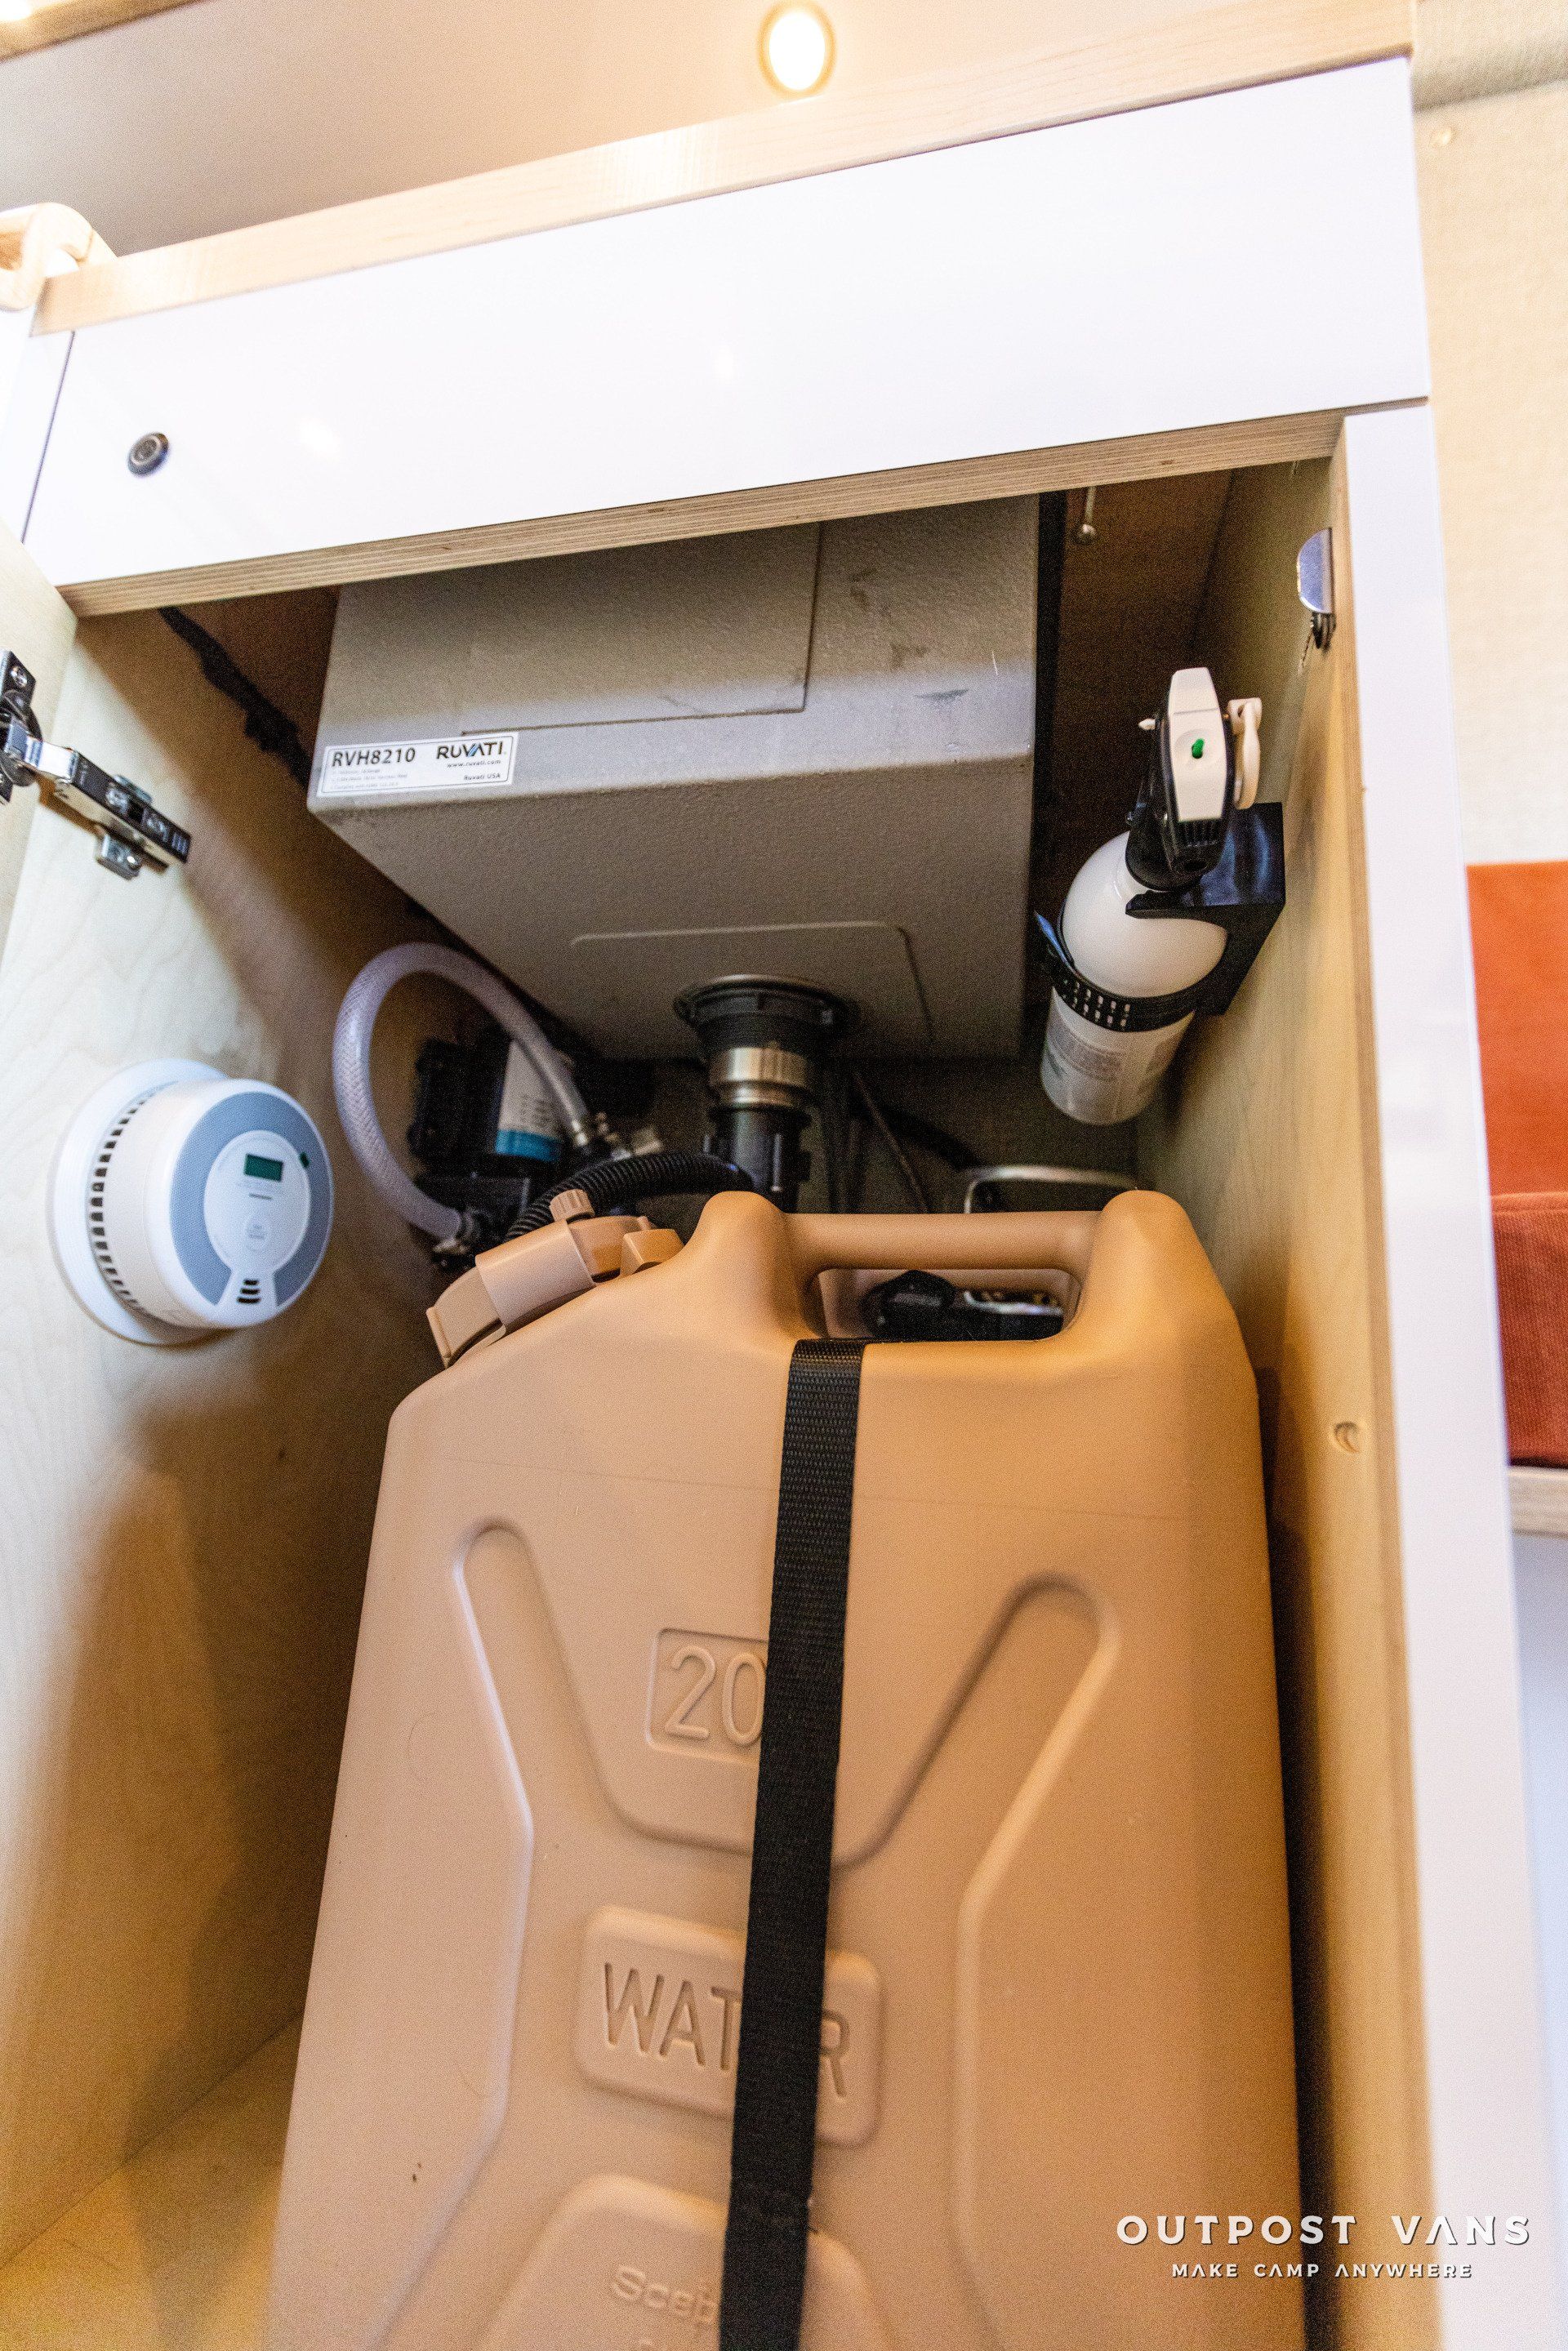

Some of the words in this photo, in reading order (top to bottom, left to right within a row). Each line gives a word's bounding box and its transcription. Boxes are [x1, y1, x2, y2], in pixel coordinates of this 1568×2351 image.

[332, 747, 416, 768] RVH8210
[436, 741, 504, 759] RUVATI
[446, 759, 501, 768] www.ruvati.com
[464, 773, 486, 781] Ruvati
[487, 772, 501, 780] USA
[663, 1644, 767, 1748] 20
[604, 1961, 850, 2099] WATR
